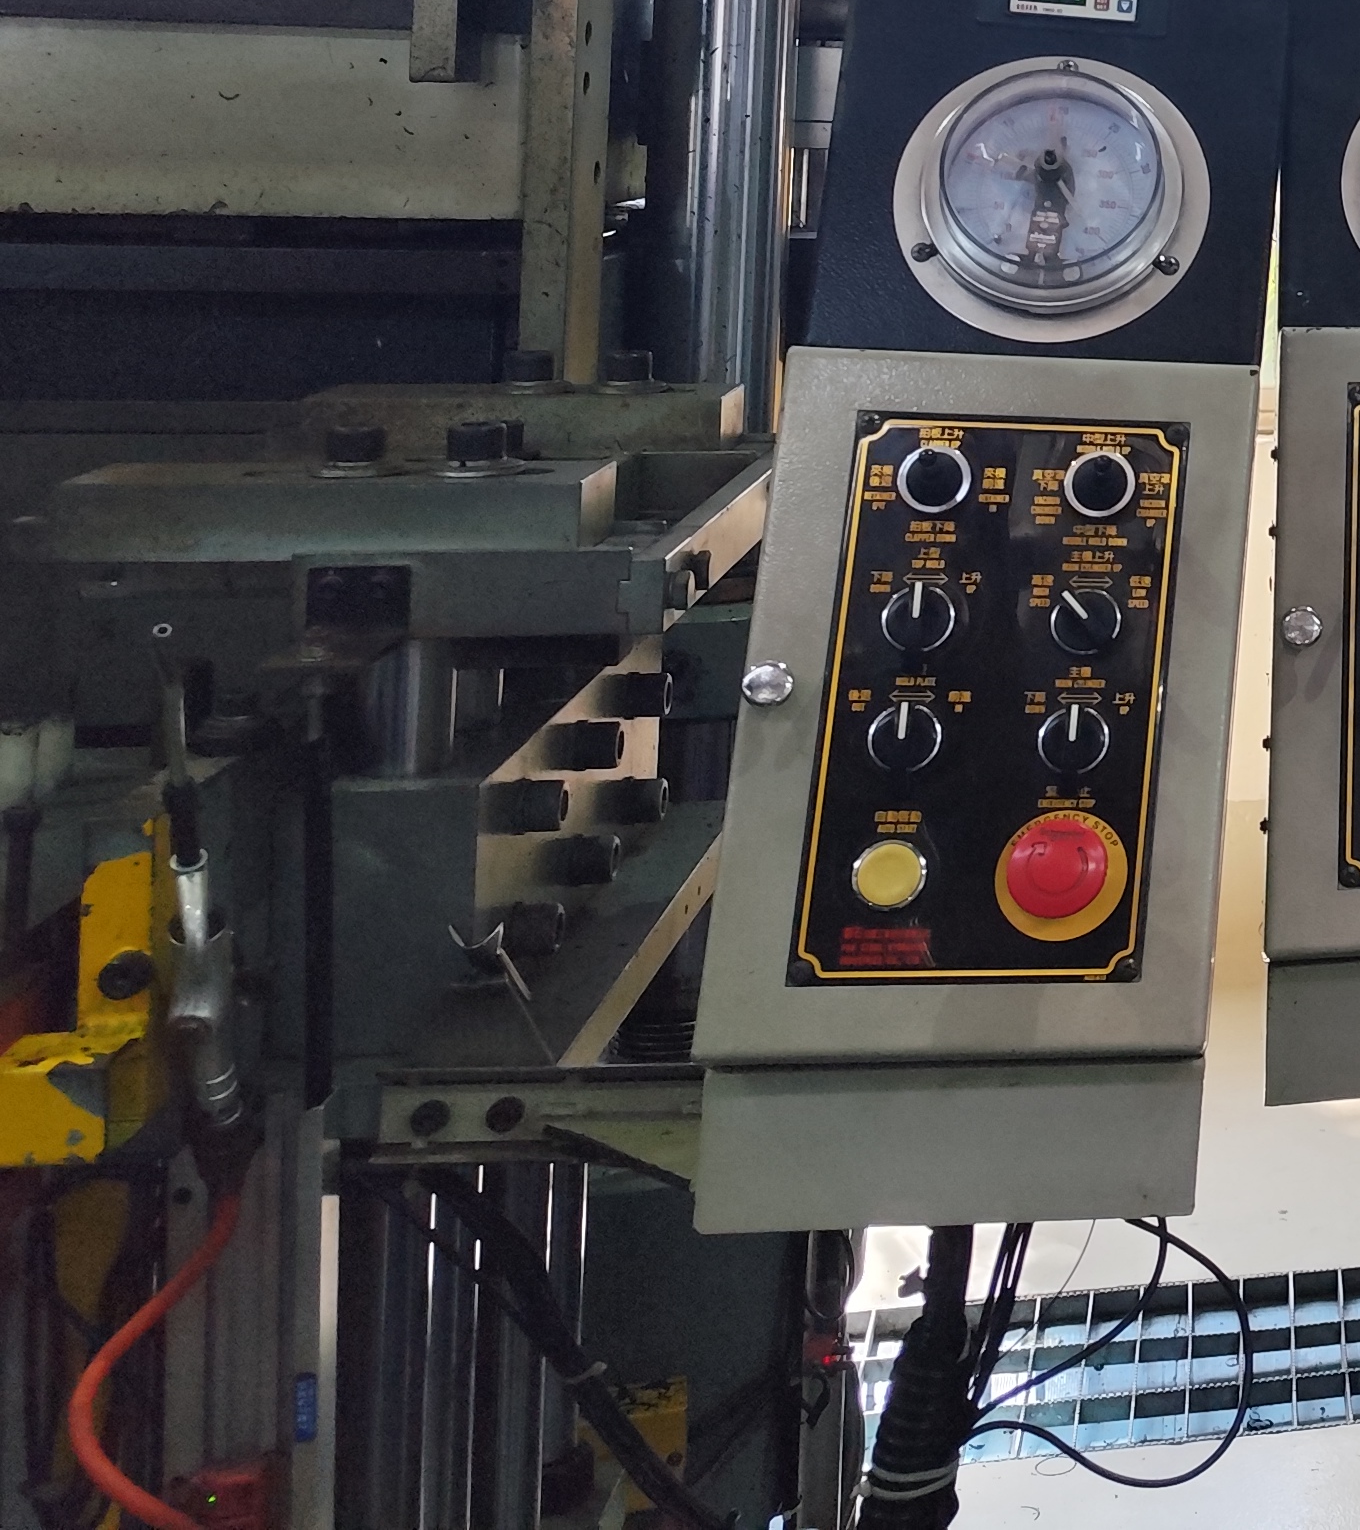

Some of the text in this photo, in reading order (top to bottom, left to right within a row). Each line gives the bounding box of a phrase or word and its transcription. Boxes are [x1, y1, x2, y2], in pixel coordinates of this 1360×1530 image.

[959, 572, 982, 583] 上升
[1112, 692, 1135, 704] 上升
[1092, 821, 1119, 847] STOP
